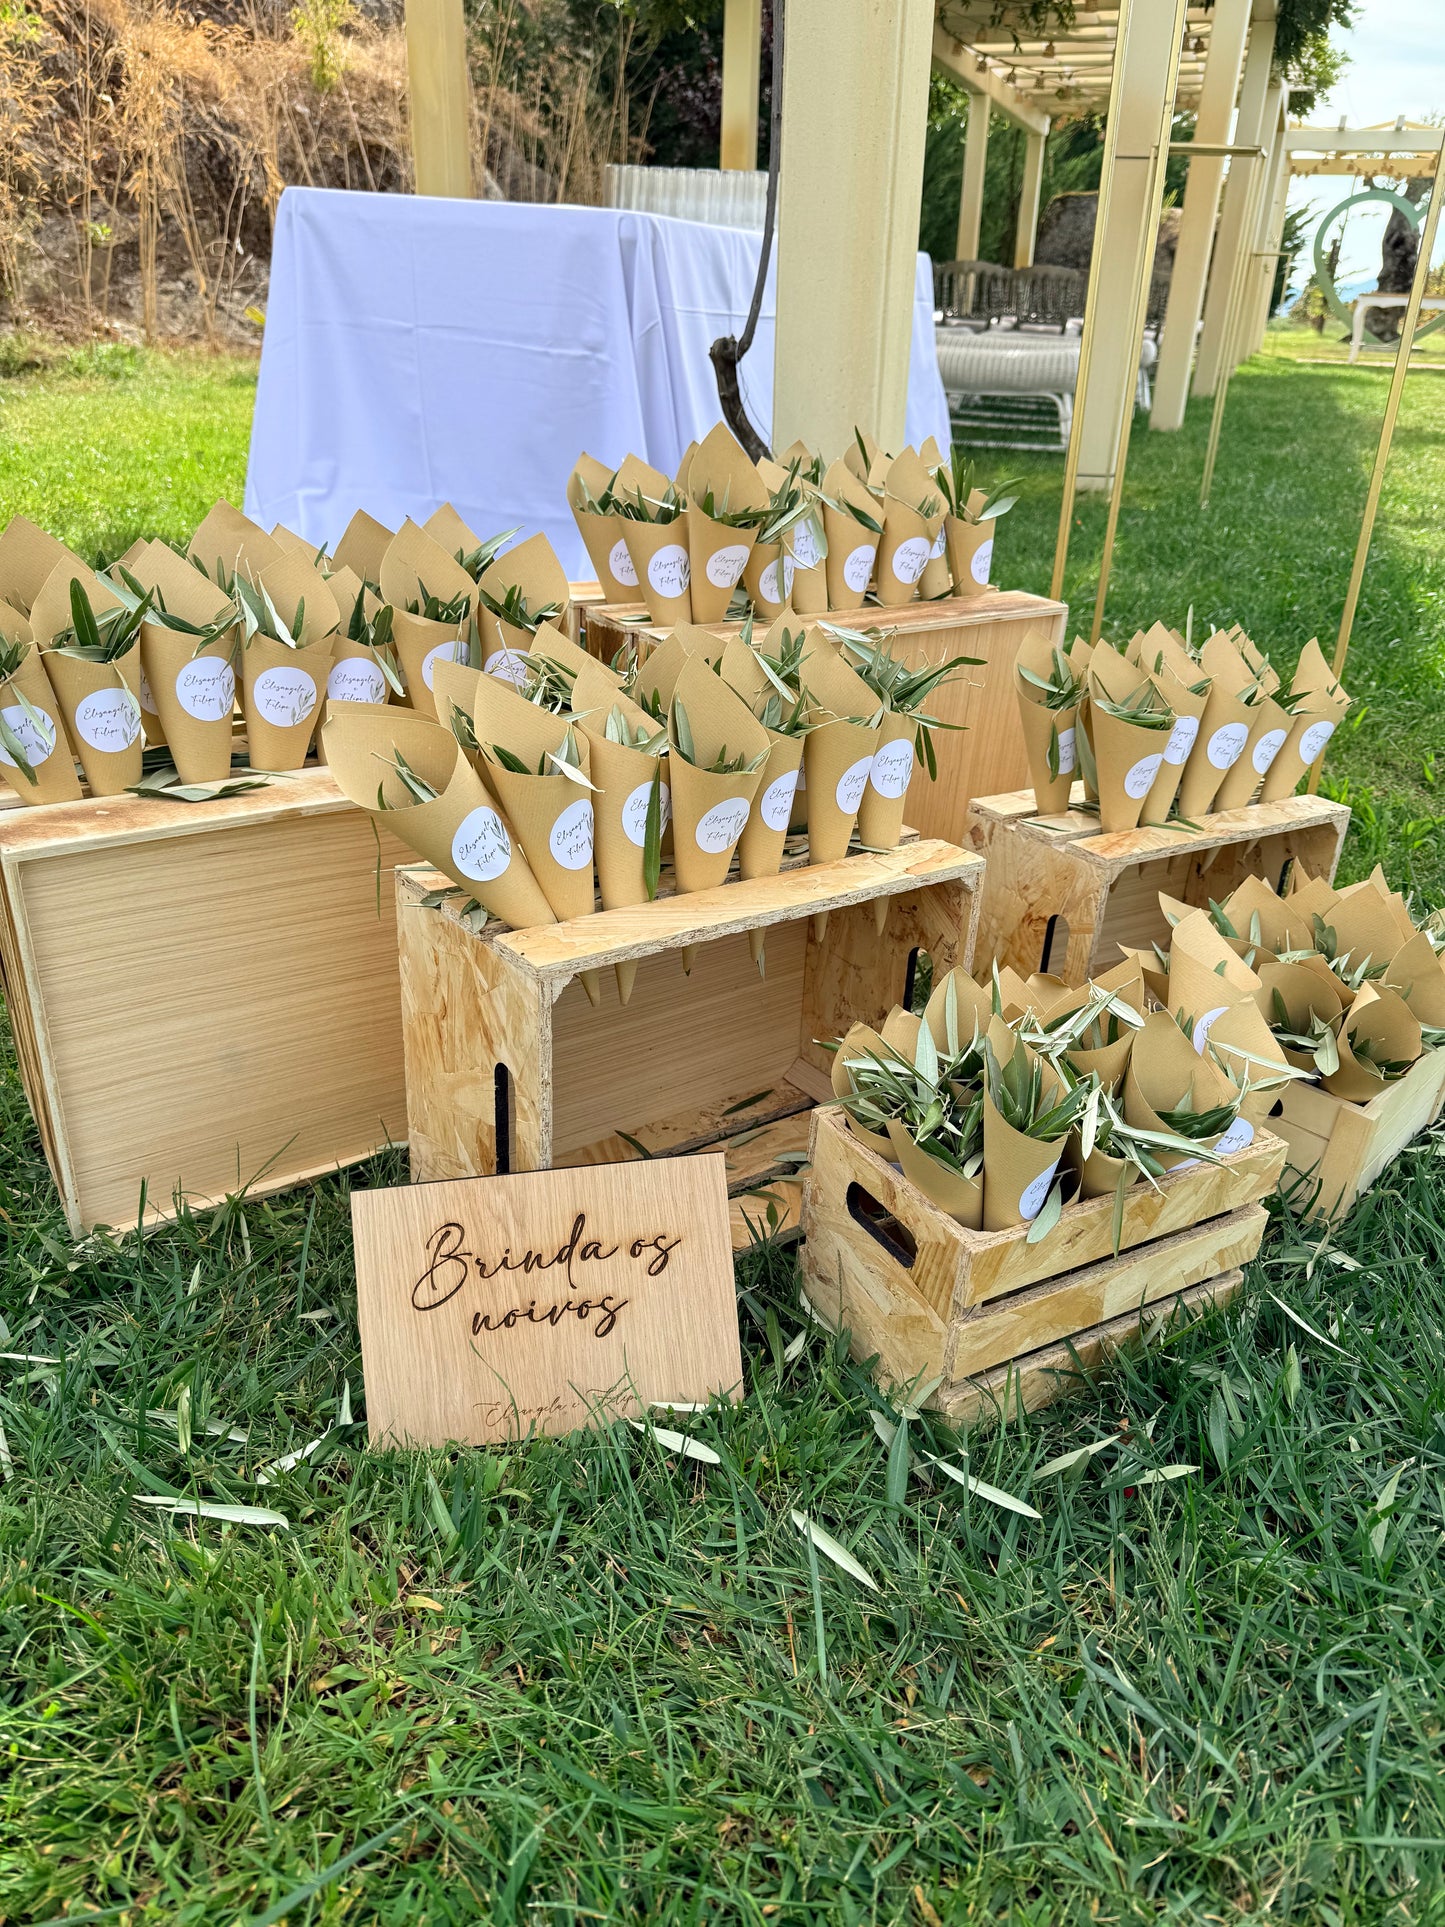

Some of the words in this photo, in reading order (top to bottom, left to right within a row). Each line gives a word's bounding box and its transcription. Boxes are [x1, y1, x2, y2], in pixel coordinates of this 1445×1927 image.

[412, 1213, 618, 1311] Brinda
[629, 1233, 681, 1276] os
[471, 1295, 629, 1338] noivos
